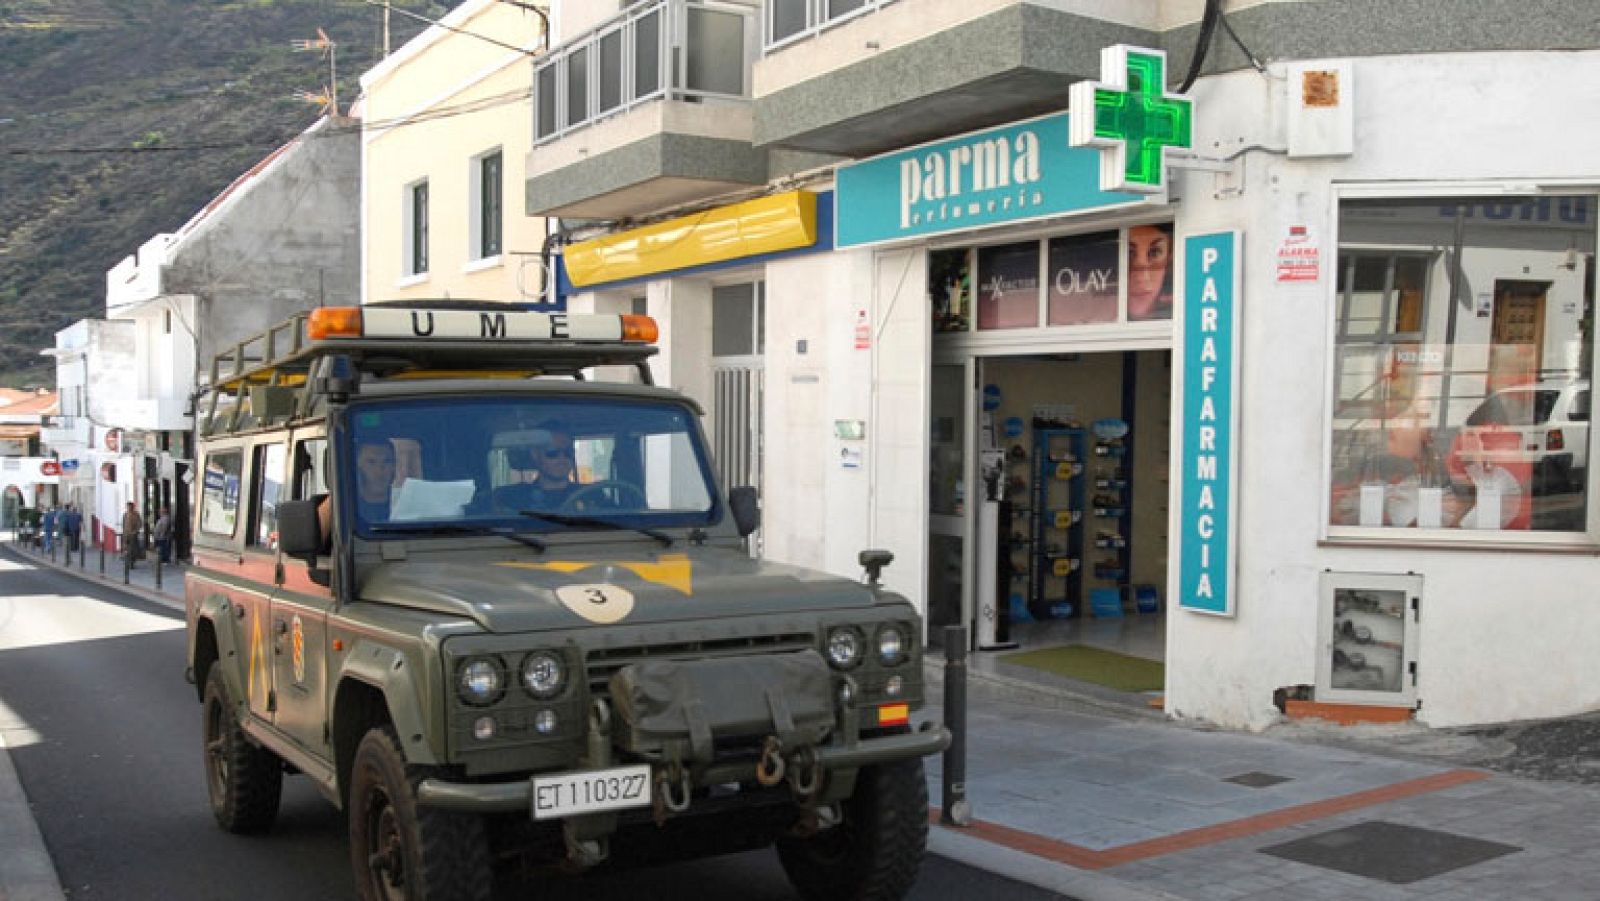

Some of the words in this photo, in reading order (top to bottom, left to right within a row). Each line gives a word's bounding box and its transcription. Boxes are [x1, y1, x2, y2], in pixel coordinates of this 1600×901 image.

[900, 131, 1041, 229] parma
[1055, 266, 1112, 295] OLAY
[1197, 248, 1218, 598] PARAFARMACIA
[584, 589, 607, 604] 3
